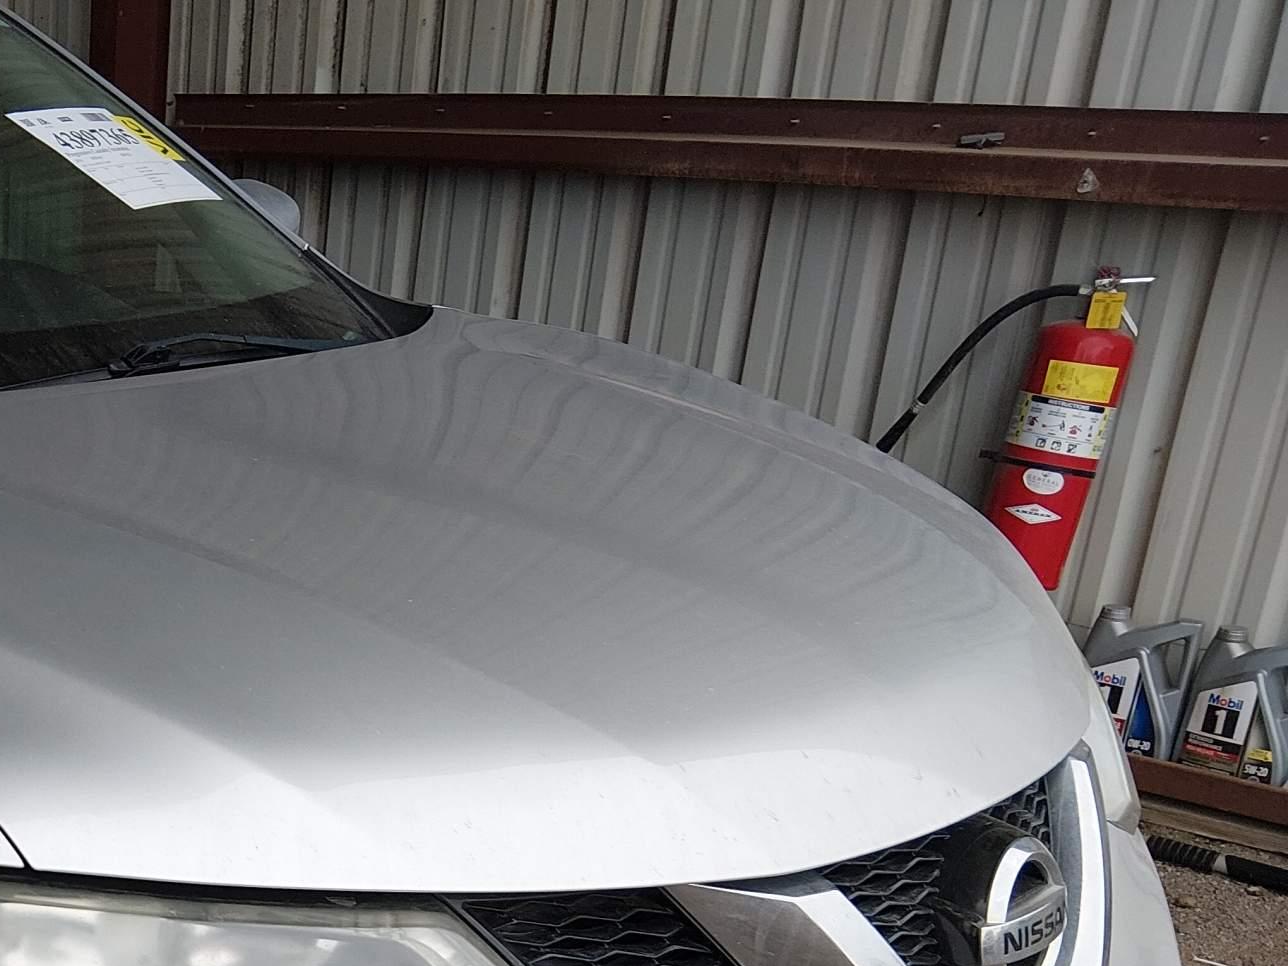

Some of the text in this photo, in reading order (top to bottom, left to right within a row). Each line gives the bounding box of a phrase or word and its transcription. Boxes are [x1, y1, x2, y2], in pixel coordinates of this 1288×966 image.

[52, 128, 140, 151] 43897365
[1094, 670, 1127, 686] Mobil
[1208, 693, 1244, 710] Mobil
[1213, 709, 1227, 735] 1
[1003, 902, 1065, 955] NISSA
